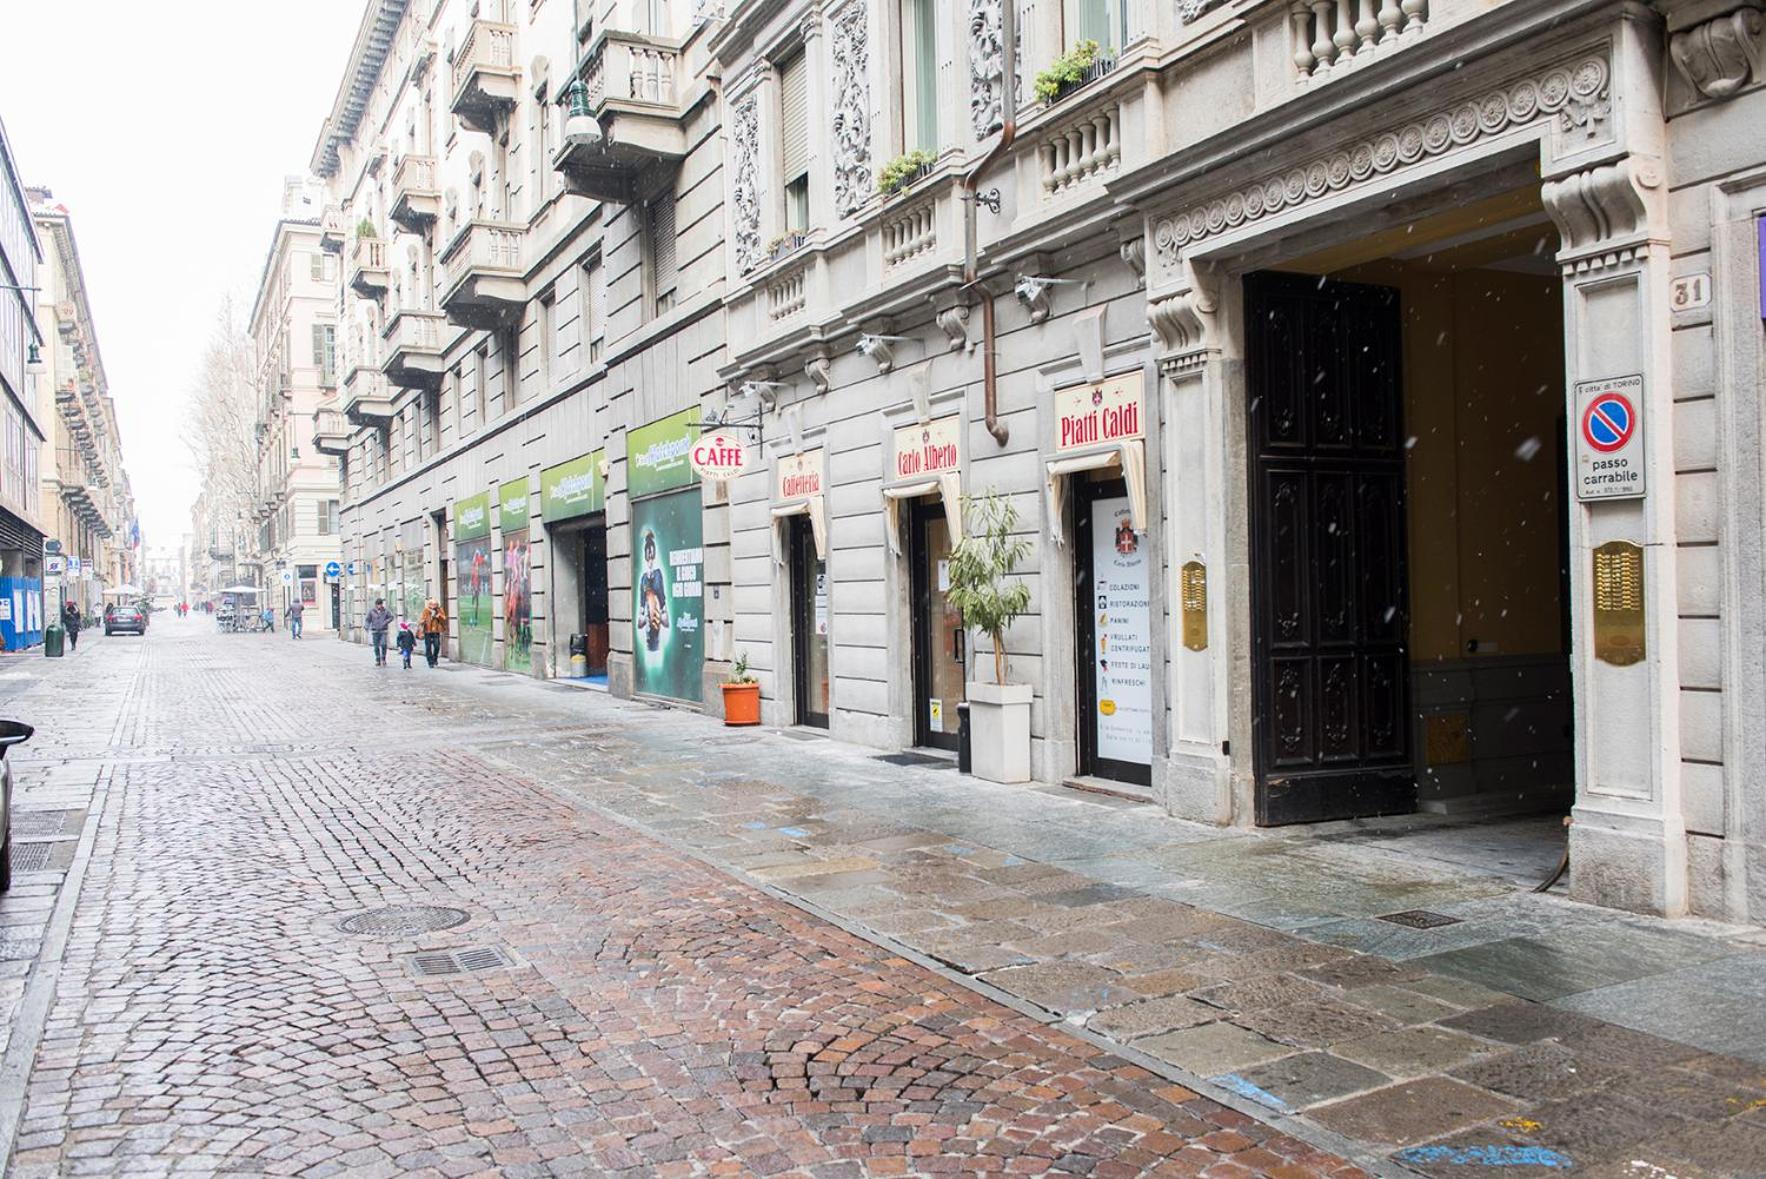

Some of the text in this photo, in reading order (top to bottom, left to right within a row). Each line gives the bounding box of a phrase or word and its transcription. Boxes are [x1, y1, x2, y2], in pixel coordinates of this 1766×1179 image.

[1675, 278, 1701, 305] 31
[1613, 379, 1640, 388] TORINO
[1061, 401, 1138, 447] Piatti Caldi
[898, 444, 957, 476] Carlo Alberto
[1592, 458, 1628, 472] passo
[1583, 471, 1638, 485] carrabile
[1109, 583, 1140, 592] COLAZIONI
